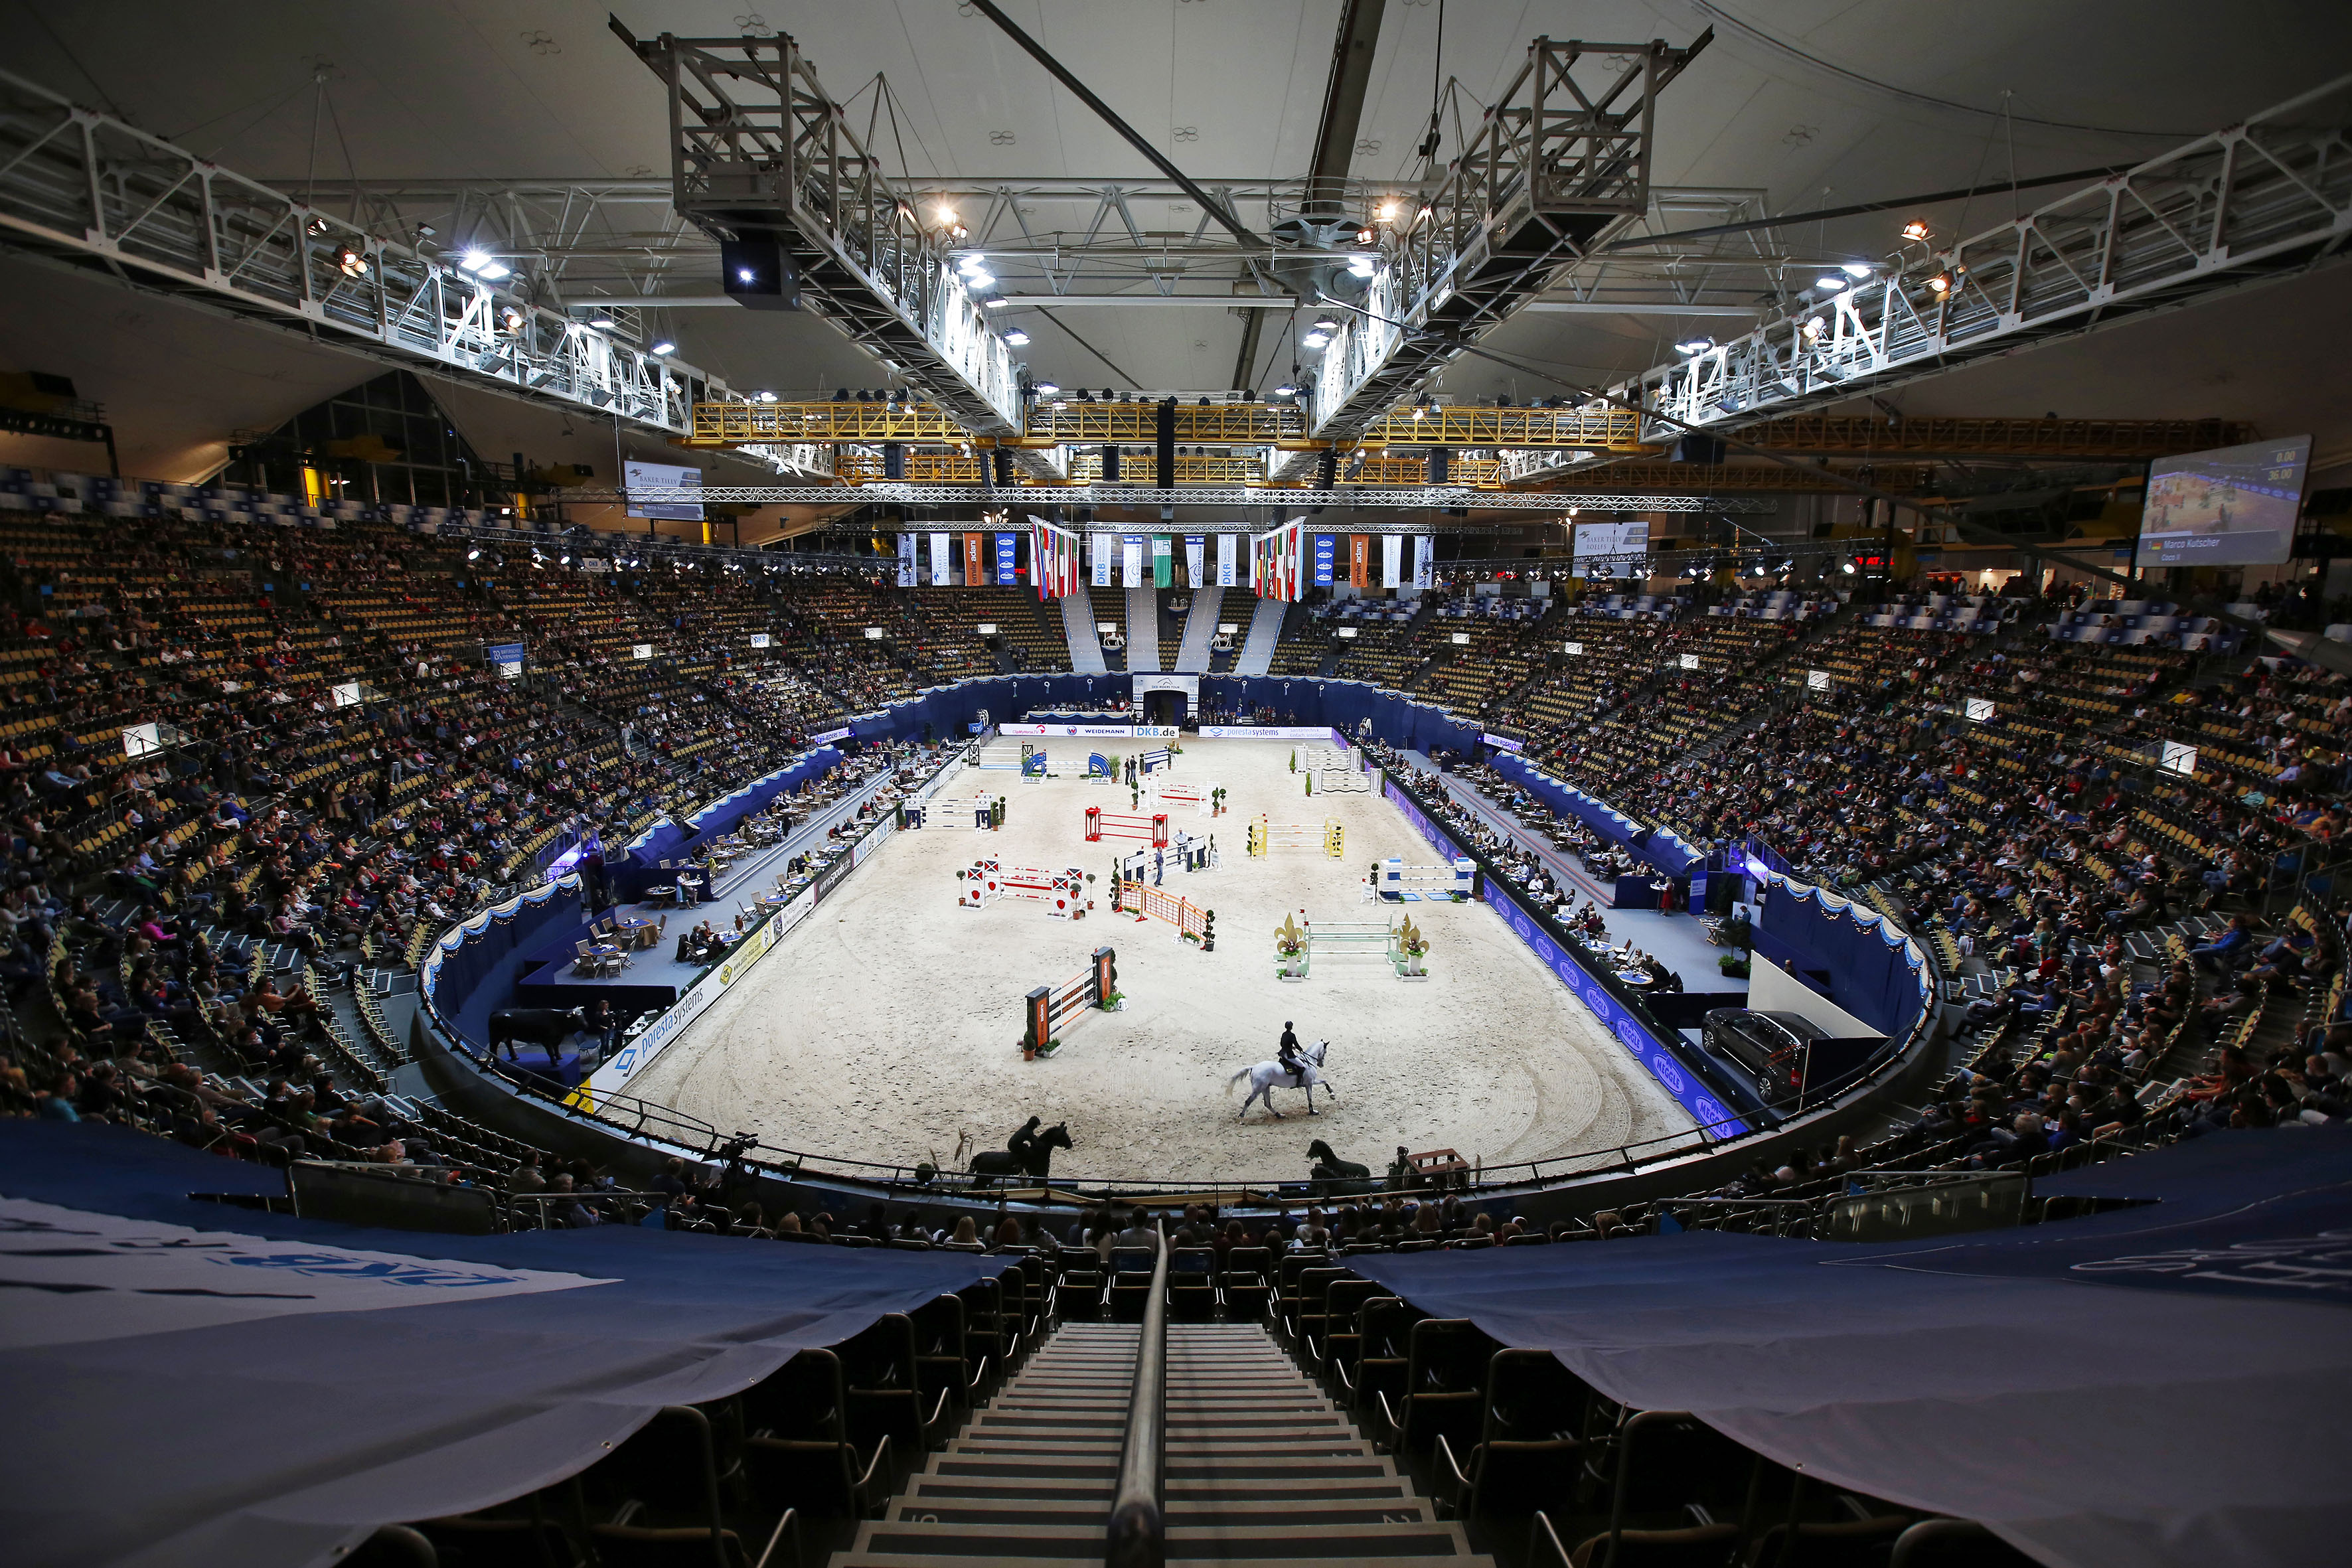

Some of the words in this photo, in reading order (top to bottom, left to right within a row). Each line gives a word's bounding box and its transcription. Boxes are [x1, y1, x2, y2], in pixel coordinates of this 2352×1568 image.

[2276, 451, 2296, 463] 0.00
[2267, 469, 2293, 481] 36.00
[2163, 539, 2185, 549] Marco
[2187, 537, 2220, 548] Kutscher
[2161, 553, 2175, 562] Coco
[493, 650, 503, 660] BR
[1137, 727, 1175, 737] DKB.de
[876, 818, 895, 842] DKB.de
[855, 837, 875, 862] DKB.de
[819, 857, 852, 894] www.spooks.de
[1537, 941, 1553, 959] MEGGLE
[1562, 965, 1578, 984] MEGGLE
[1588, 990, 1607, 1014] MEGGLE
[1620, 1022, 1640, 1049] MEGGLE
[1657, 1061, 1680, 1089] MEGGLE
[1700, 1102, 1728, 1135] MEGGLE
